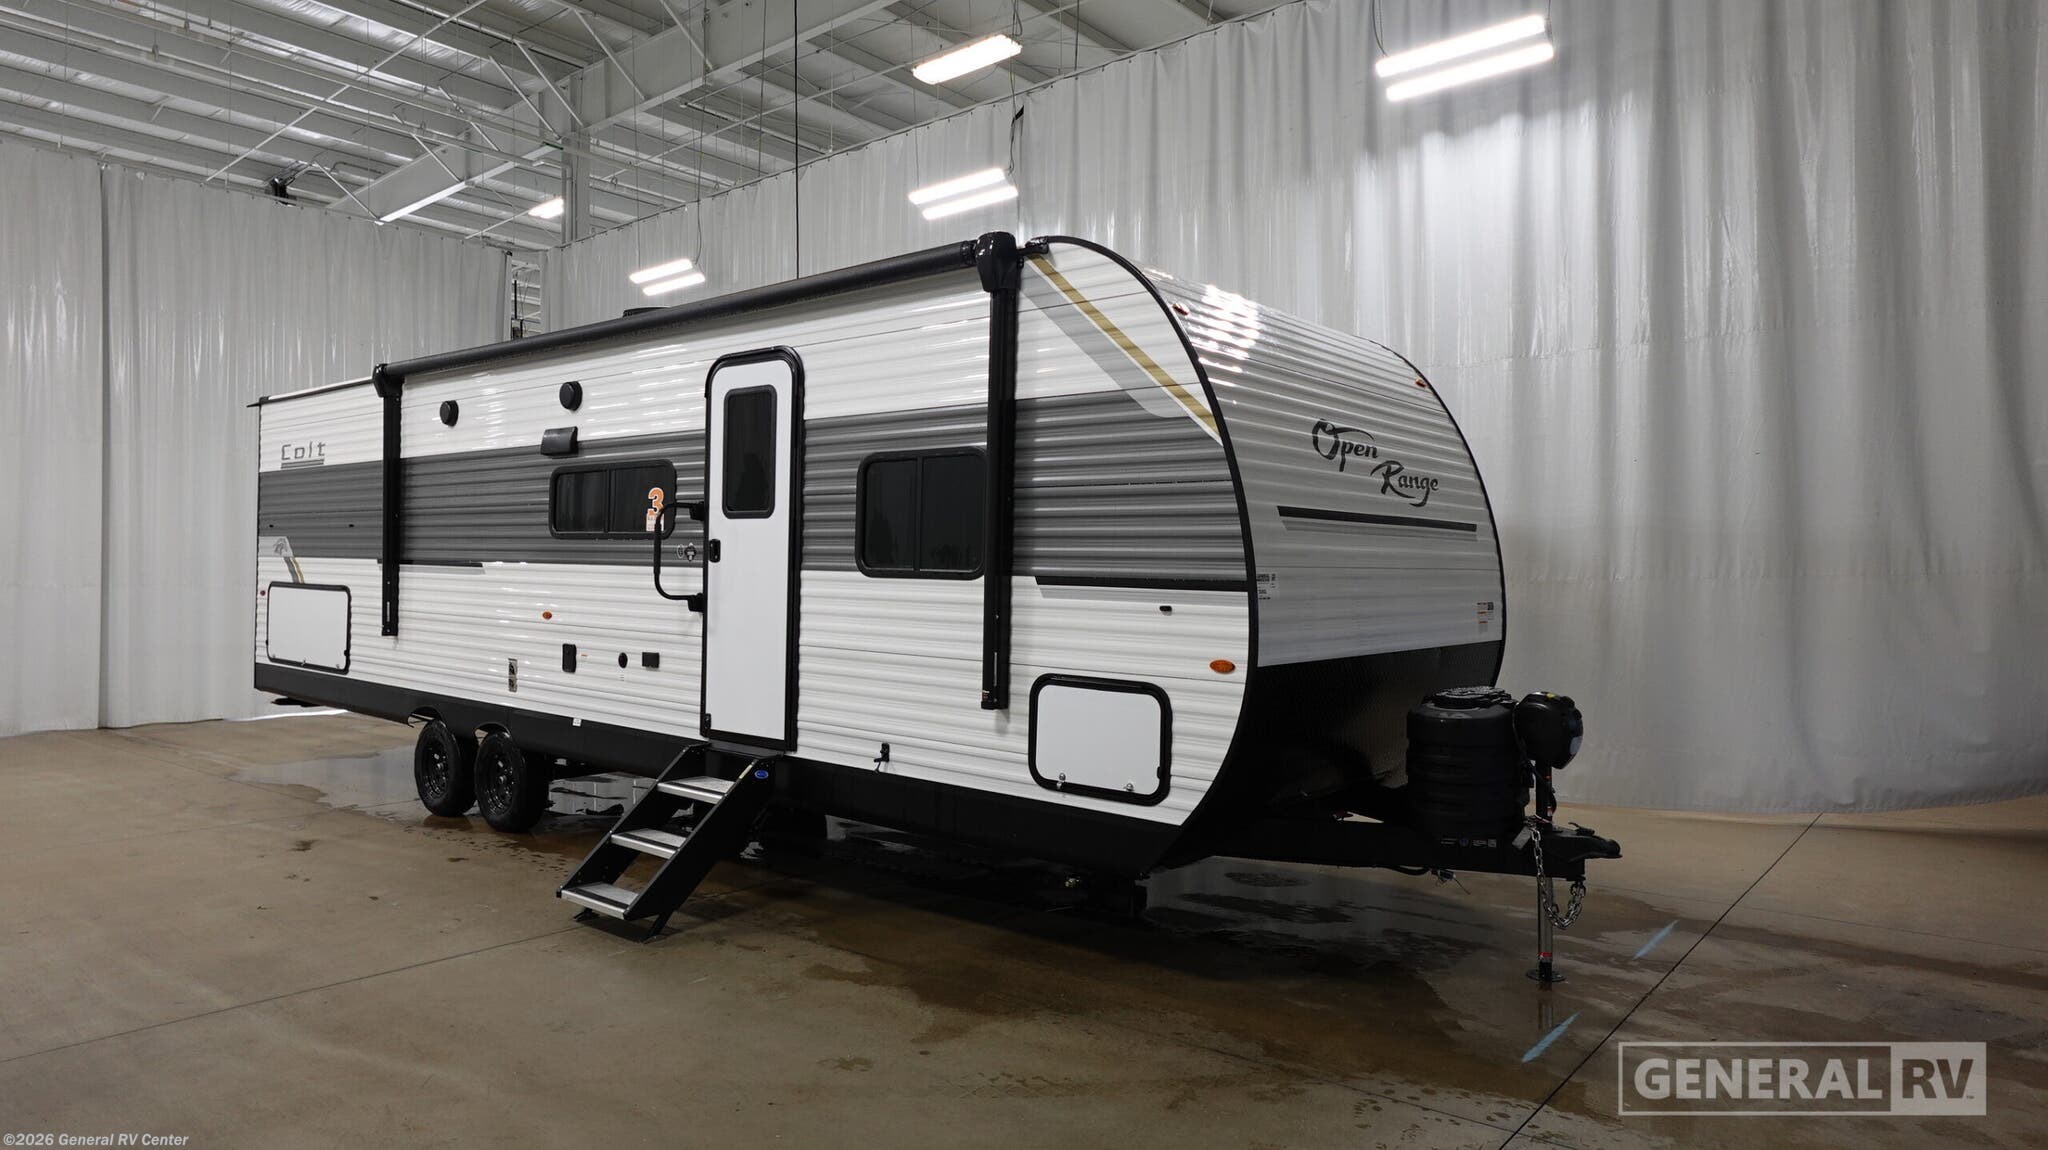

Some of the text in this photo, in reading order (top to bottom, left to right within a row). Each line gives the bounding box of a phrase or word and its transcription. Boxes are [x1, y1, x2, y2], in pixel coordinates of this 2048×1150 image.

[281, 441, 326, 461] Colt
[1312, 418, 1378, 472] Open
[648, 487, 664, 515] 3
[1370, 460, 1439, 508] Range
